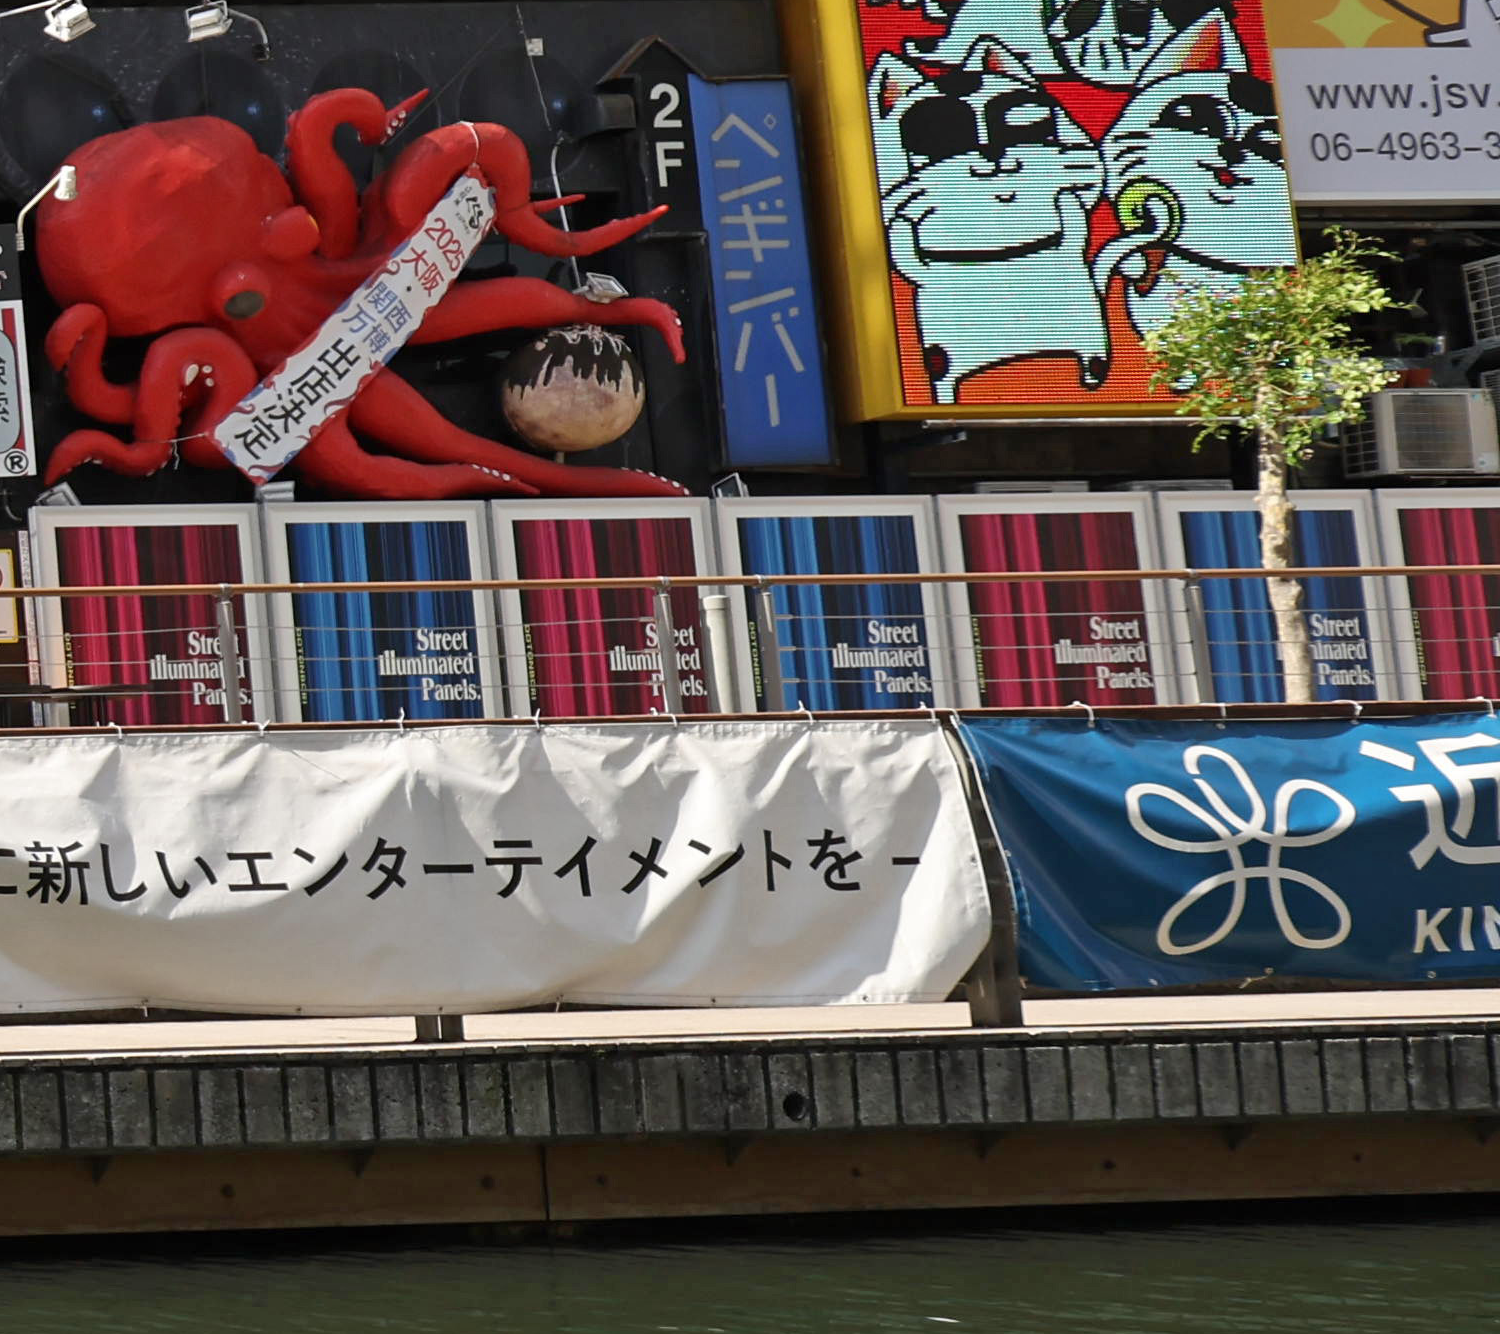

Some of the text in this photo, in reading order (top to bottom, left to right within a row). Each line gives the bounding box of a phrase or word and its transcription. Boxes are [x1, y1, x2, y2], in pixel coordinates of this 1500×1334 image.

[650, 82, 686, 187] 2F
[423, 217, 465, 272] 2025
[710, 111, 804, 428] ペンギンバー
[364, 281, 410, 332] 関西
[341, 304, 393, 356] 万博
[235, 336, 364, 462] 出店決定
[868, 620, 919, 643] Street
[1089, 616, 1140, 639] Street
[1311, 614, 1360, 637] Street
[188, 631, 239, 655] Stret
[417, 628, 468, 651] Street
[1054, 639, 1147, 664] Illuminated
[151, 654, 246, 680] Illuminatd
[378, 650, 474, 675] Illuminated
[832, 643, 925, 667] Illuminated
[874, 670, 931, 693] Panels.
[1096, 666, 1153, 689] Panels.
[1317, 663, 1374, 685] Panels.
[193, 682, 252, 705] Pans.
[421, 678, 481, 701] Panels.
